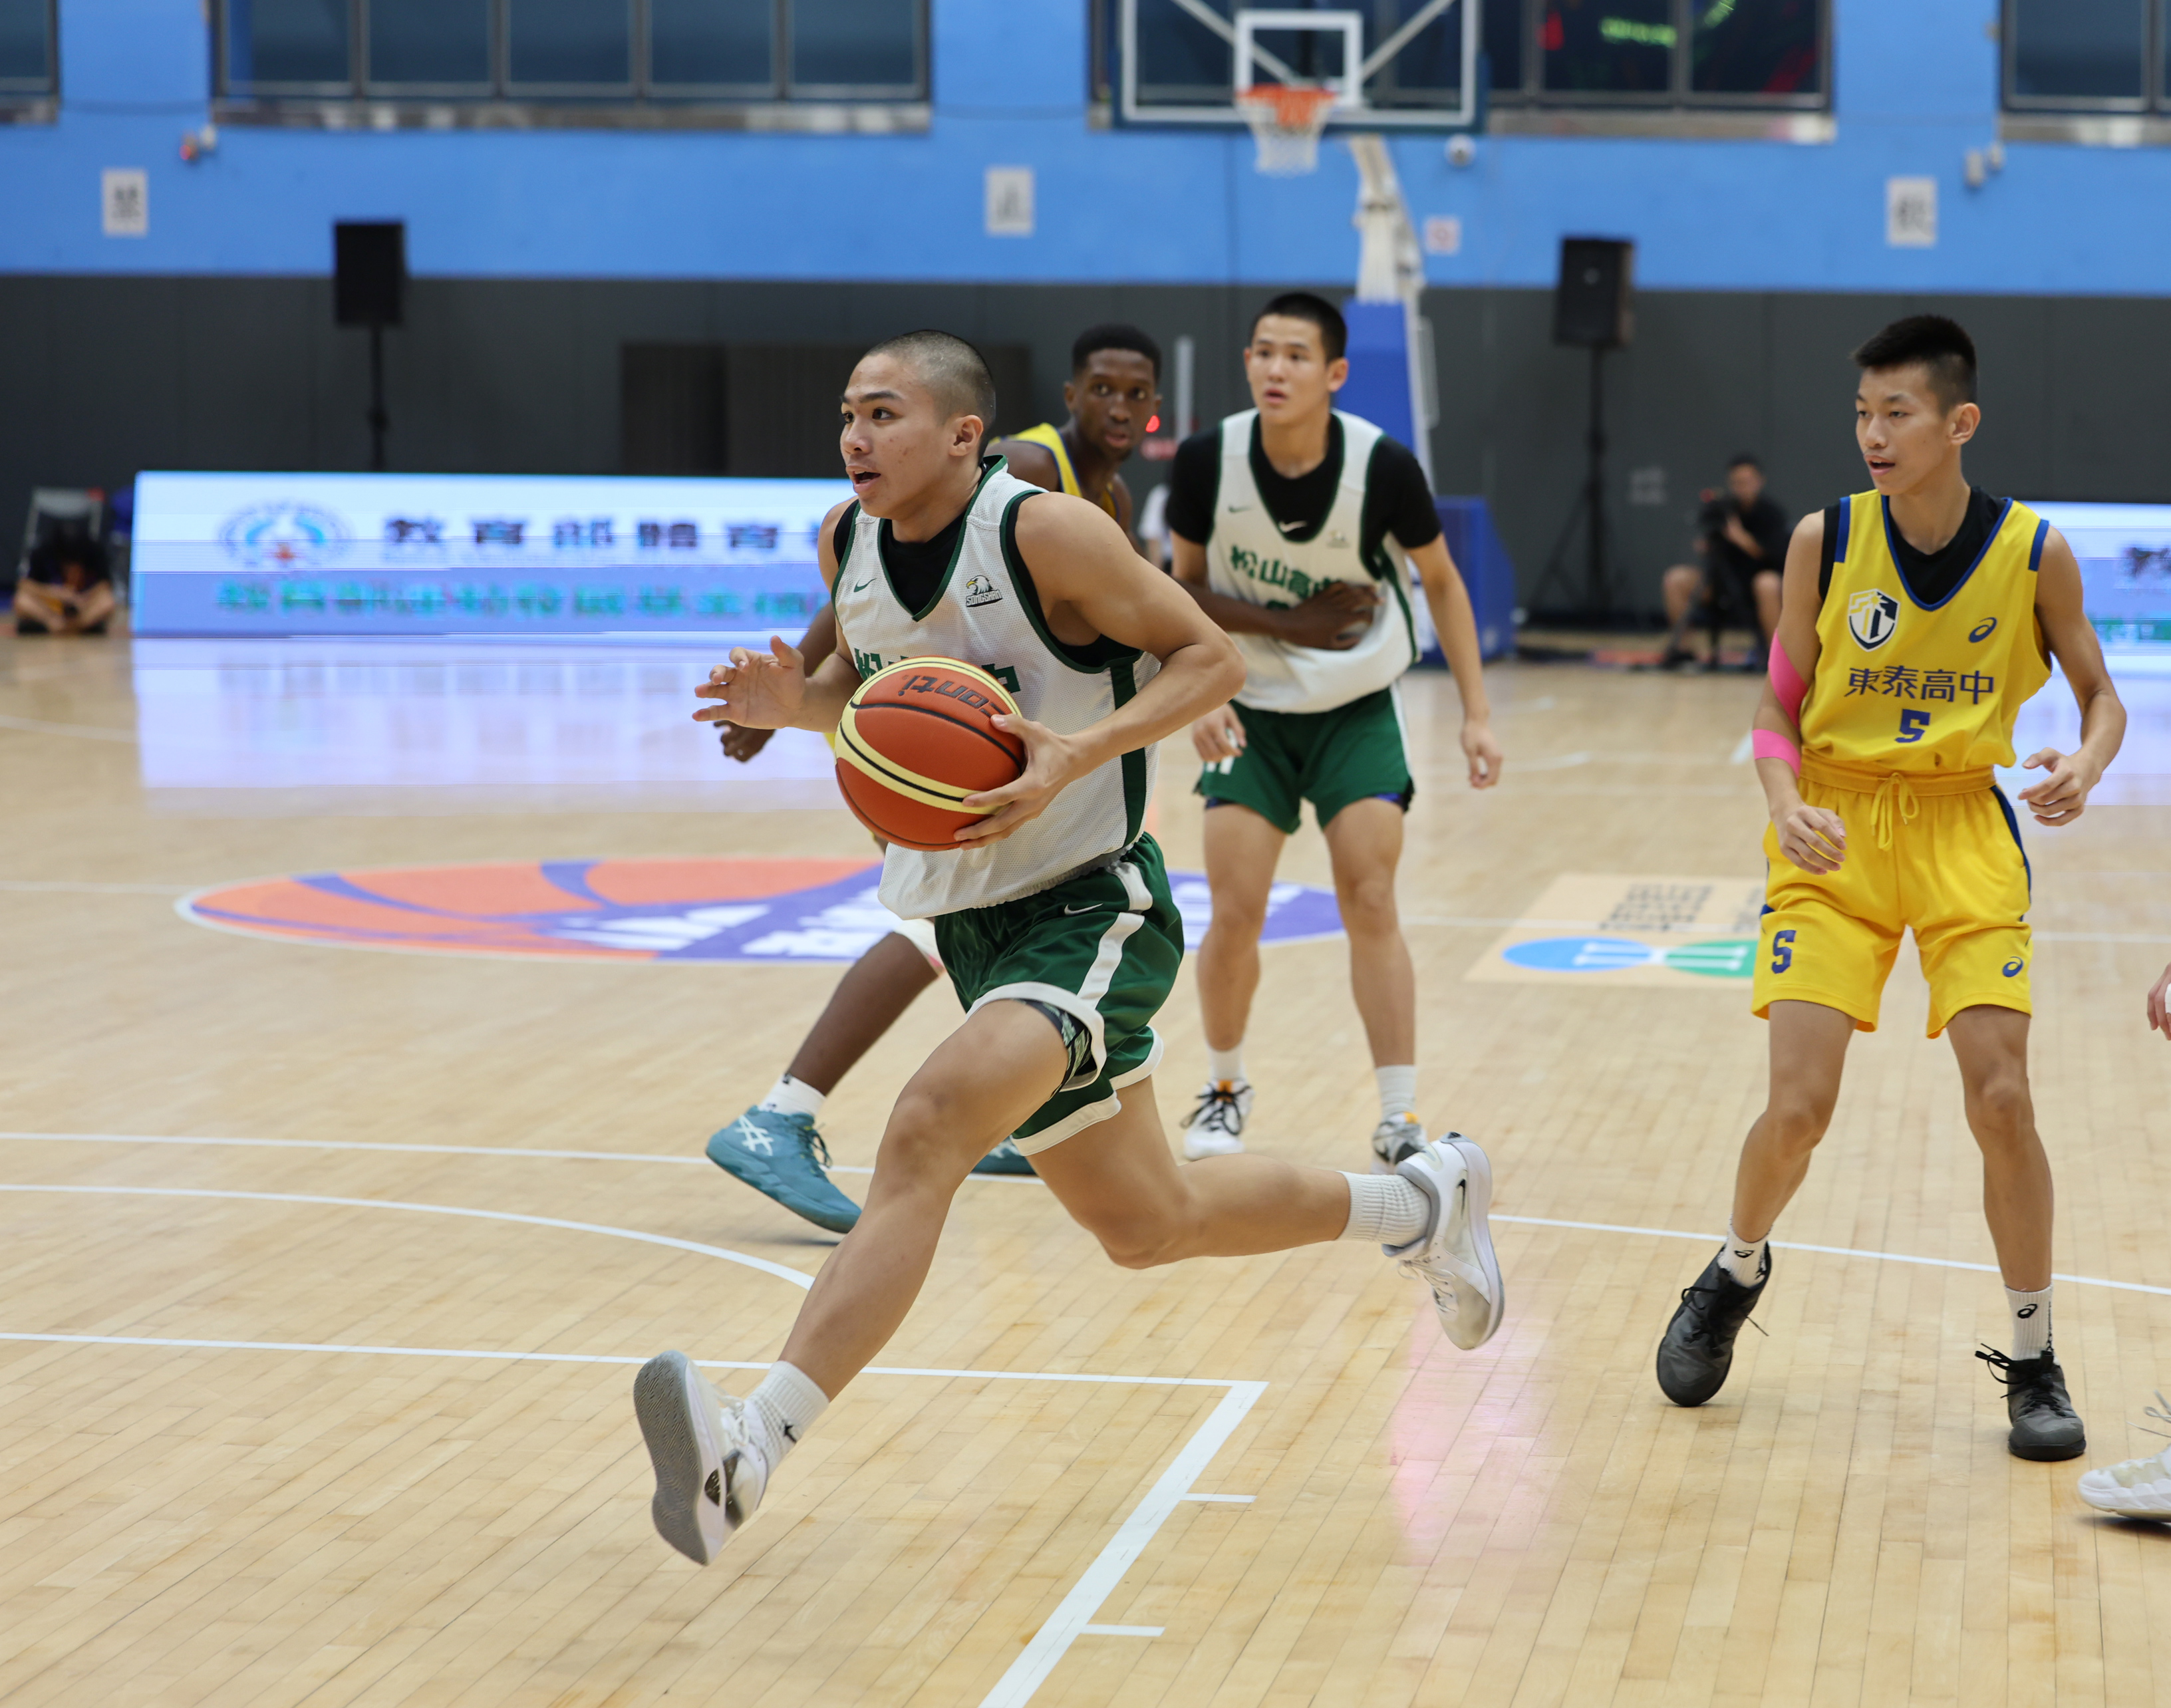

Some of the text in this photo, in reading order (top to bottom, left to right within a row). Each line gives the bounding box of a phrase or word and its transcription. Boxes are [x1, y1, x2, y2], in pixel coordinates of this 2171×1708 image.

[966, 589, 1003, 607] SONGSHAN
[1844, 665, 1994, 704] 東泰高中
[1894, 708, 1931, 744] 5
[1771, 929, 1797, 974] 5
